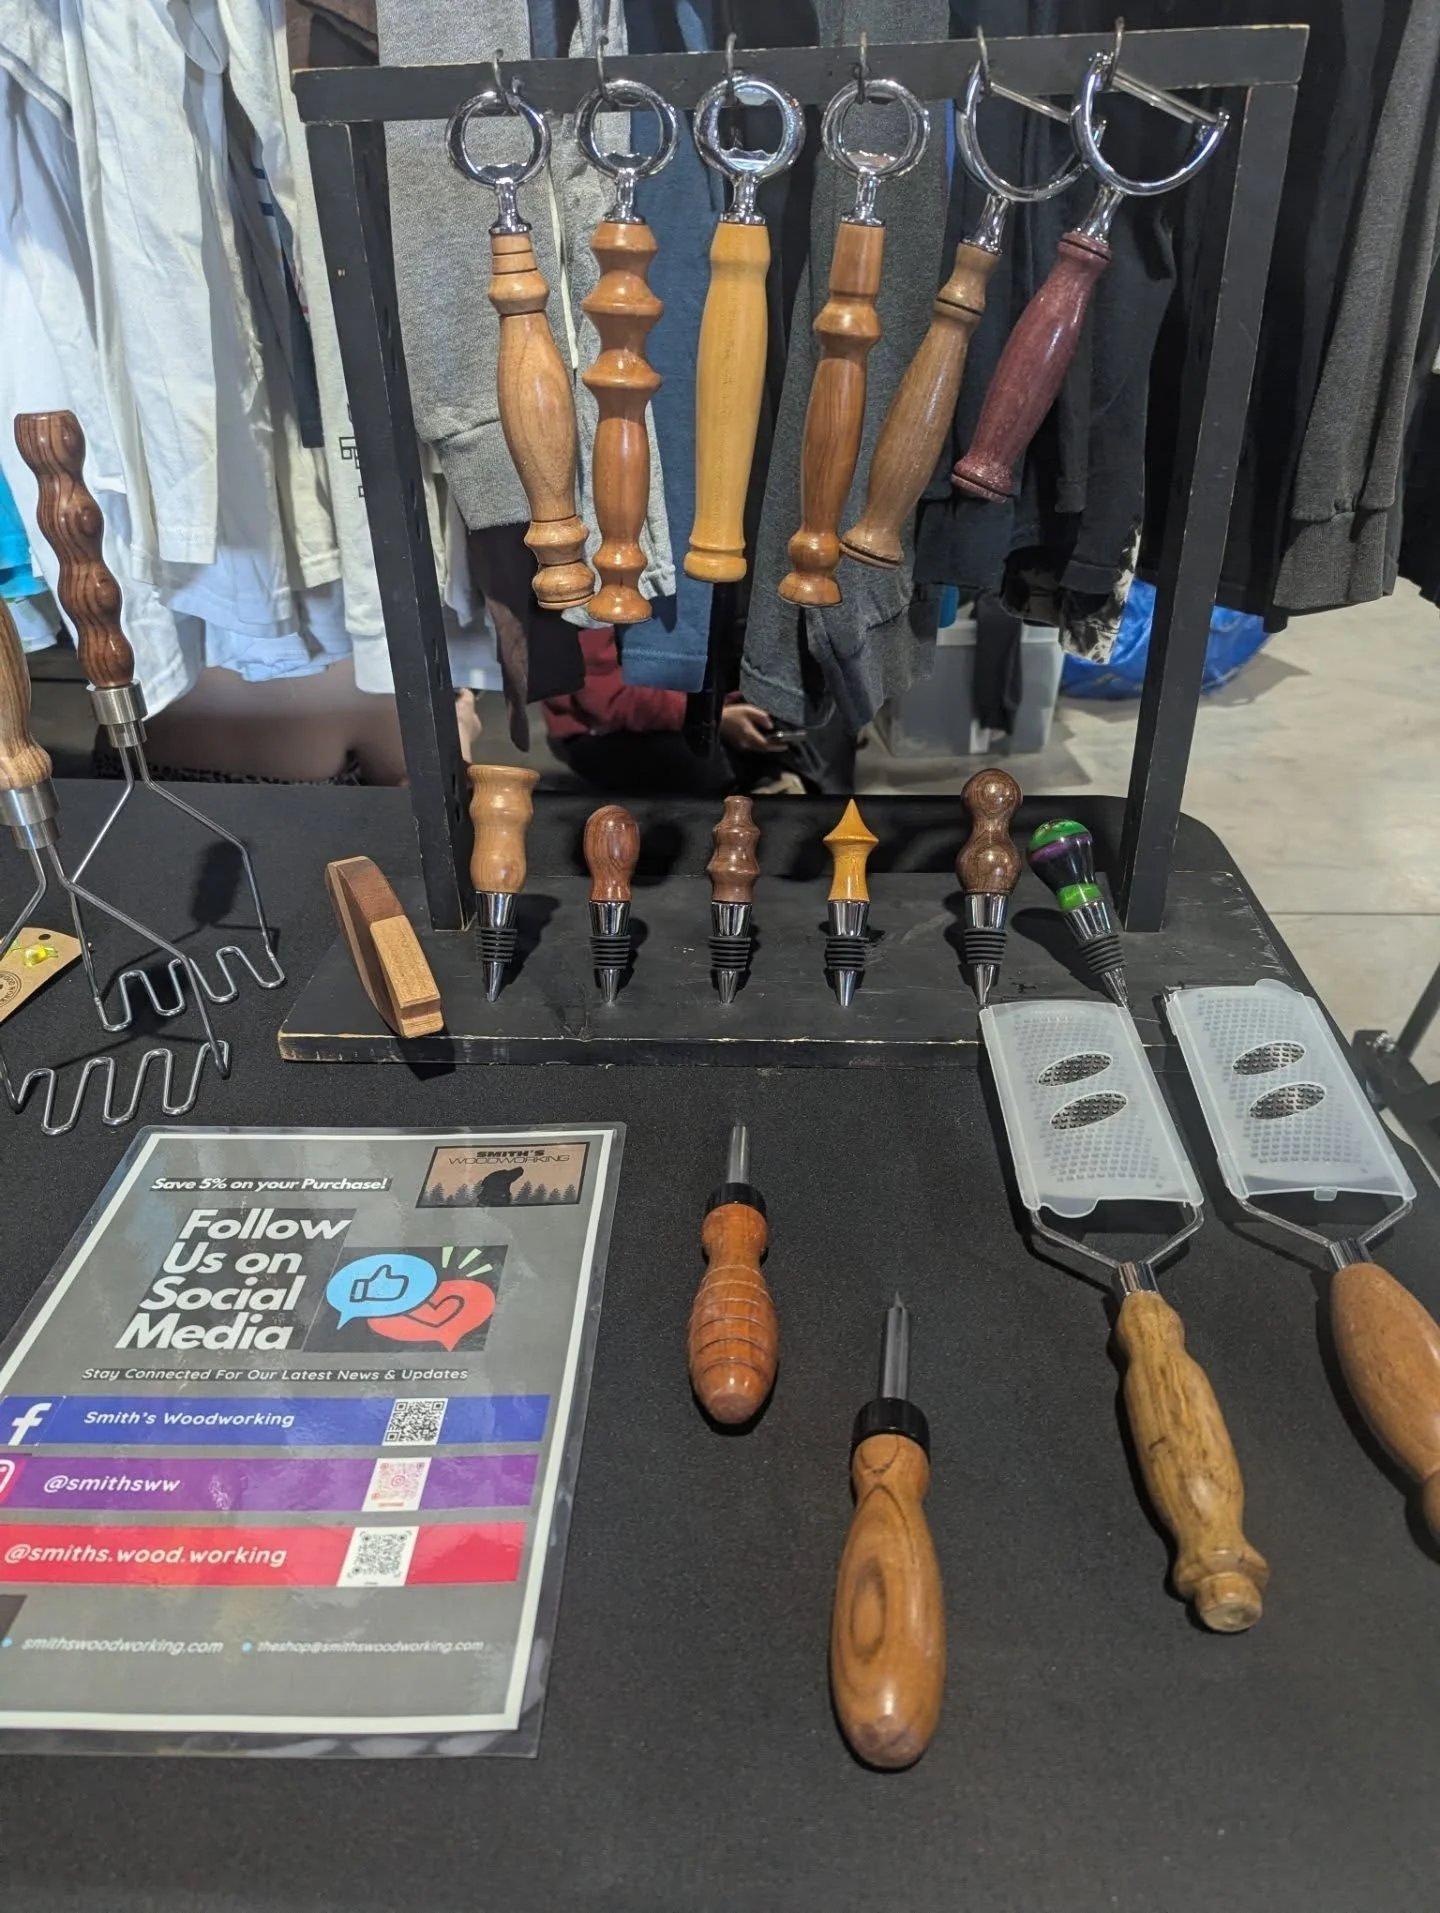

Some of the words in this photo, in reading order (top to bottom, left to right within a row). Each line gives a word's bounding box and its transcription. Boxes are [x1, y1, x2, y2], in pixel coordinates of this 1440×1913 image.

[448, 1154, 570, 1165] WOODWORKING
[476, 1149, 545, 1158] SMITH'S
[151, 1177, 196, 1190] Save
[198, 1177, 227, 1190] 5%
[230, 1180, 253, 1190] on
[254, 1180, 299, 1193] your
[301, 1177, 387, 1191] Purchase!
[178, 1207, 353, 1241] Follow
[162, 1241, 228, 1275] Us
[234, 1252, 303, 1275] on
[139, 1275, 307, 1311] Social
[114, 1311, 294, 1350] Media
[82, 1368, 120, 1382] Stay
[124, 1368, 212, 1380] Connected
[214, 1369, 244, 1381] For
[247, 1369, 278, 1381] Our
[281, 1369, 332, 1381] Latest
[337, 1369, 380, 1381] News
[384, 1369, 396, 1381] &
[401, 1368, 468, 1382] Updates
[7, 1402, 52, 1446] f
[83, 1410, 156, 1425] Smith's
[163, 1411, 295, 1428] Woodworking
[43, 1474, 181, 1493] @smithsww
[4, 1543, 288, 1568] @smiths.wood.working
[21, 1637, 224, 1656] smithswoodworking.com
[257, 1640, 485, 1654] theshop@smithswoodworking.com
